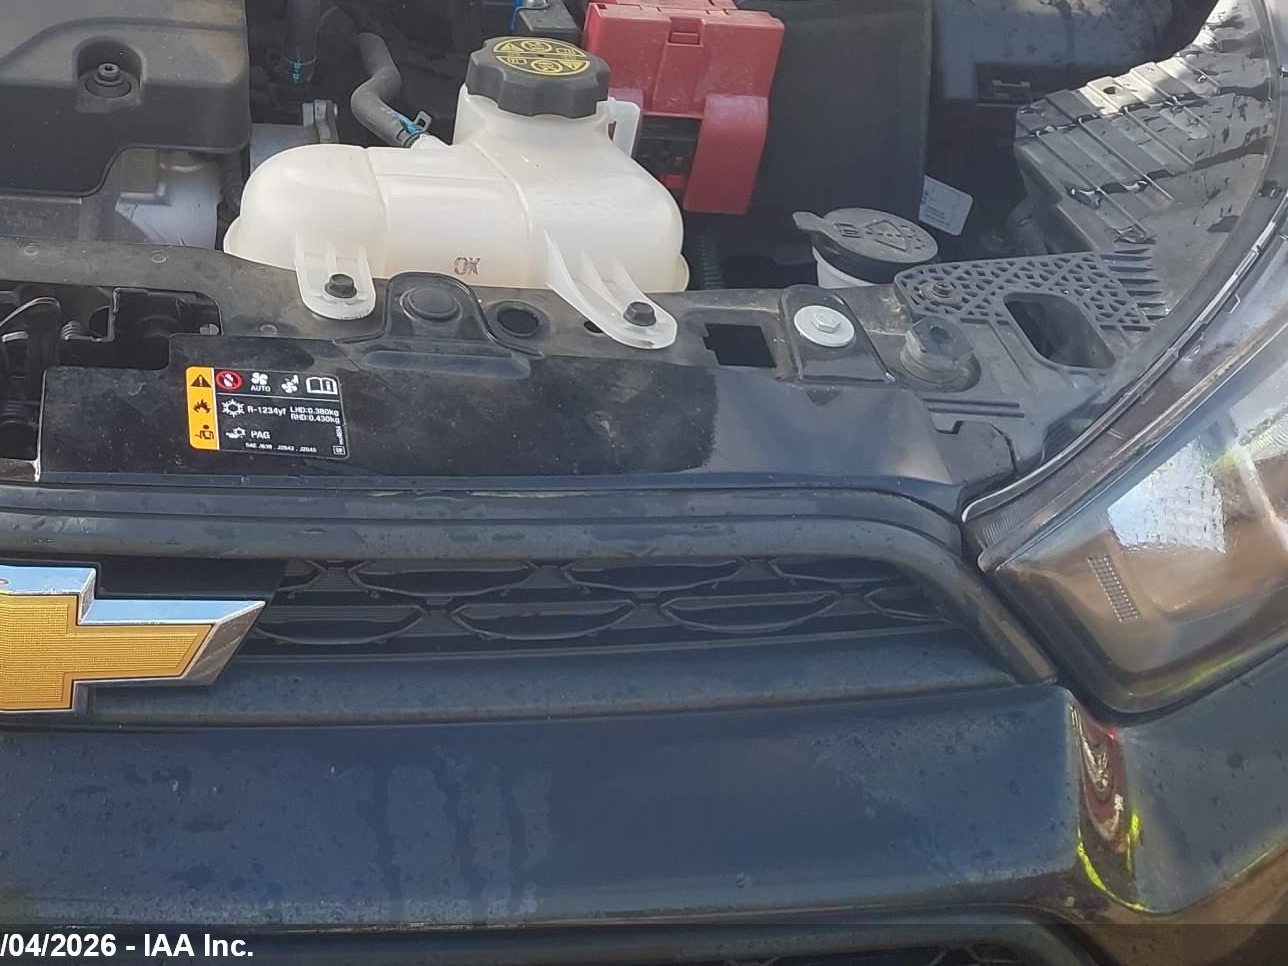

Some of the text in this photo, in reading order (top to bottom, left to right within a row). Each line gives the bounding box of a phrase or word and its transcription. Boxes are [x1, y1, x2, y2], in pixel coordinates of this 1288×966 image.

[454, 256, 481, 275] OK
[247, 405, 287, 417] R-1234yf
[251, 430, 271, 439] PAG
